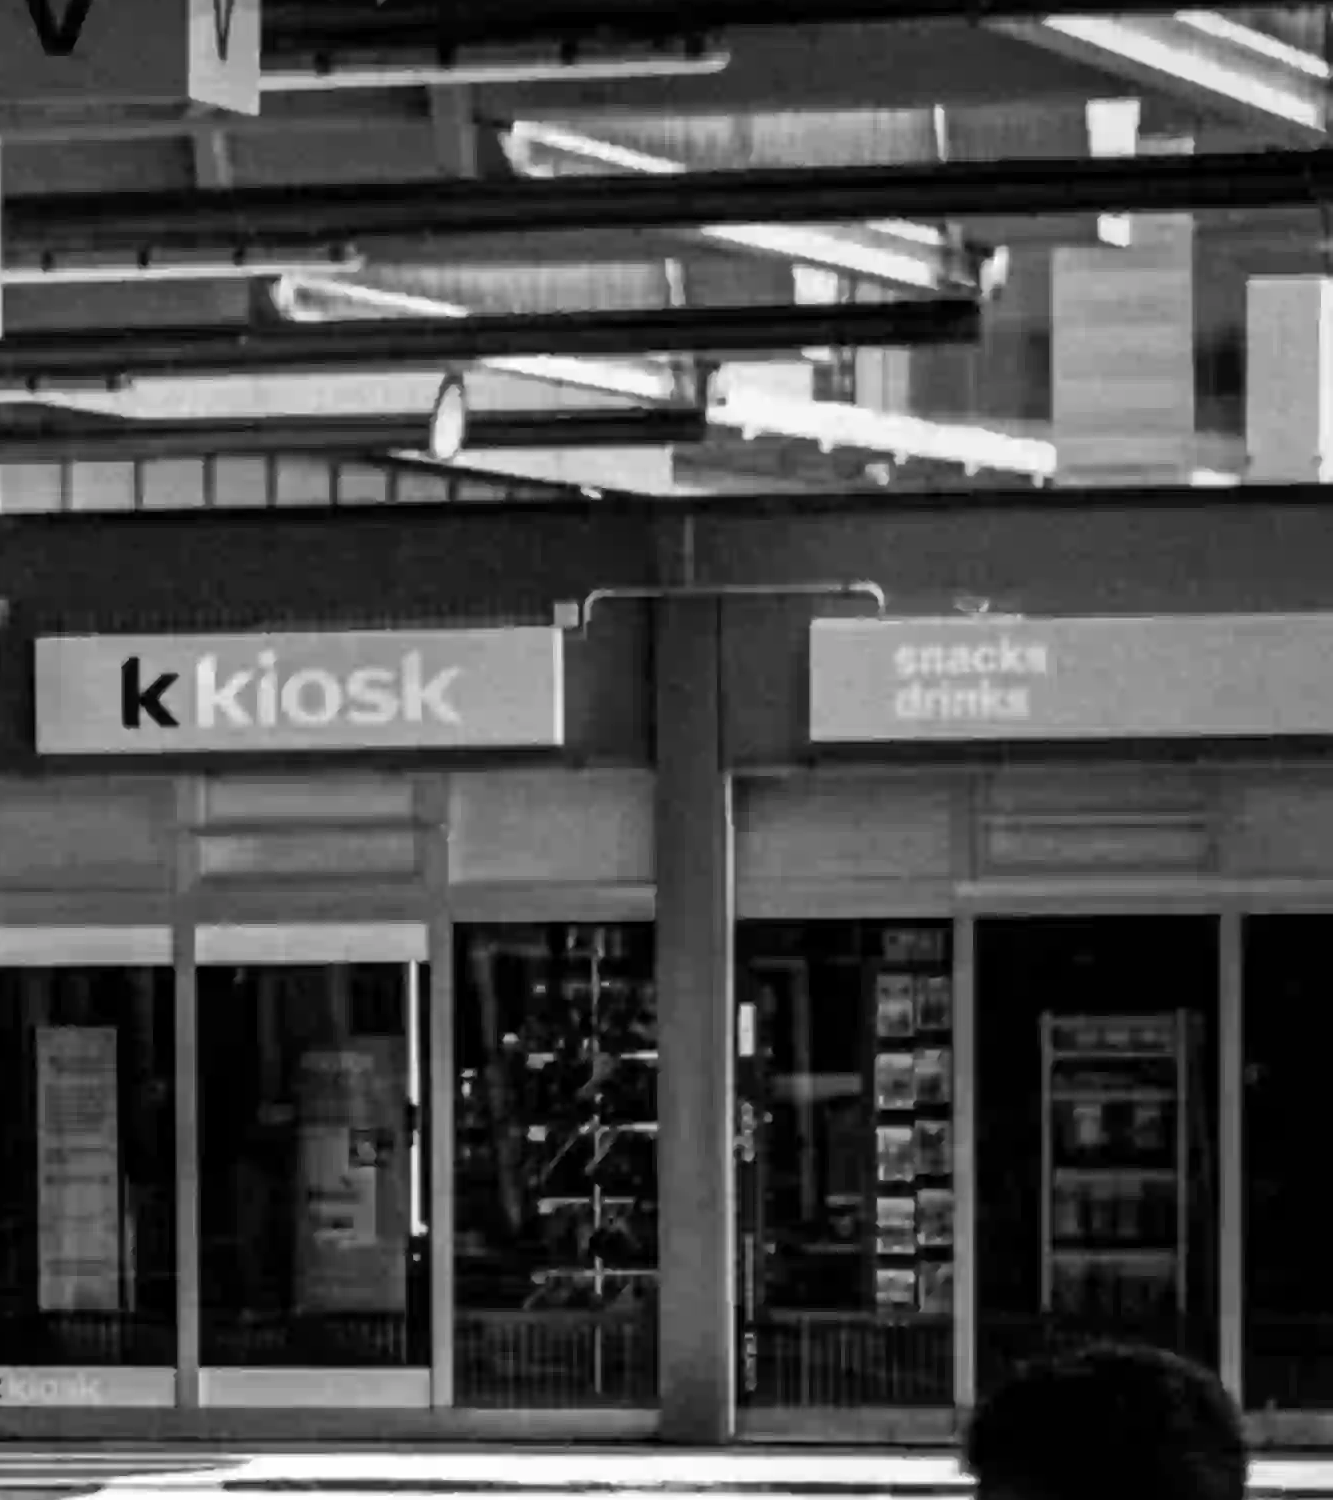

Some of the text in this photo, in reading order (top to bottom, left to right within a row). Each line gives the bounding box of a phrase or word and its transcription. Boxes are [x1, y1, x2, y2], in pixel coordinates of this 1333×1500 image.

[893, 633, 1047, 675] snacks
[121, 649, 464, 729] k kiosk
[894, 679, 1030, 719] drinks
